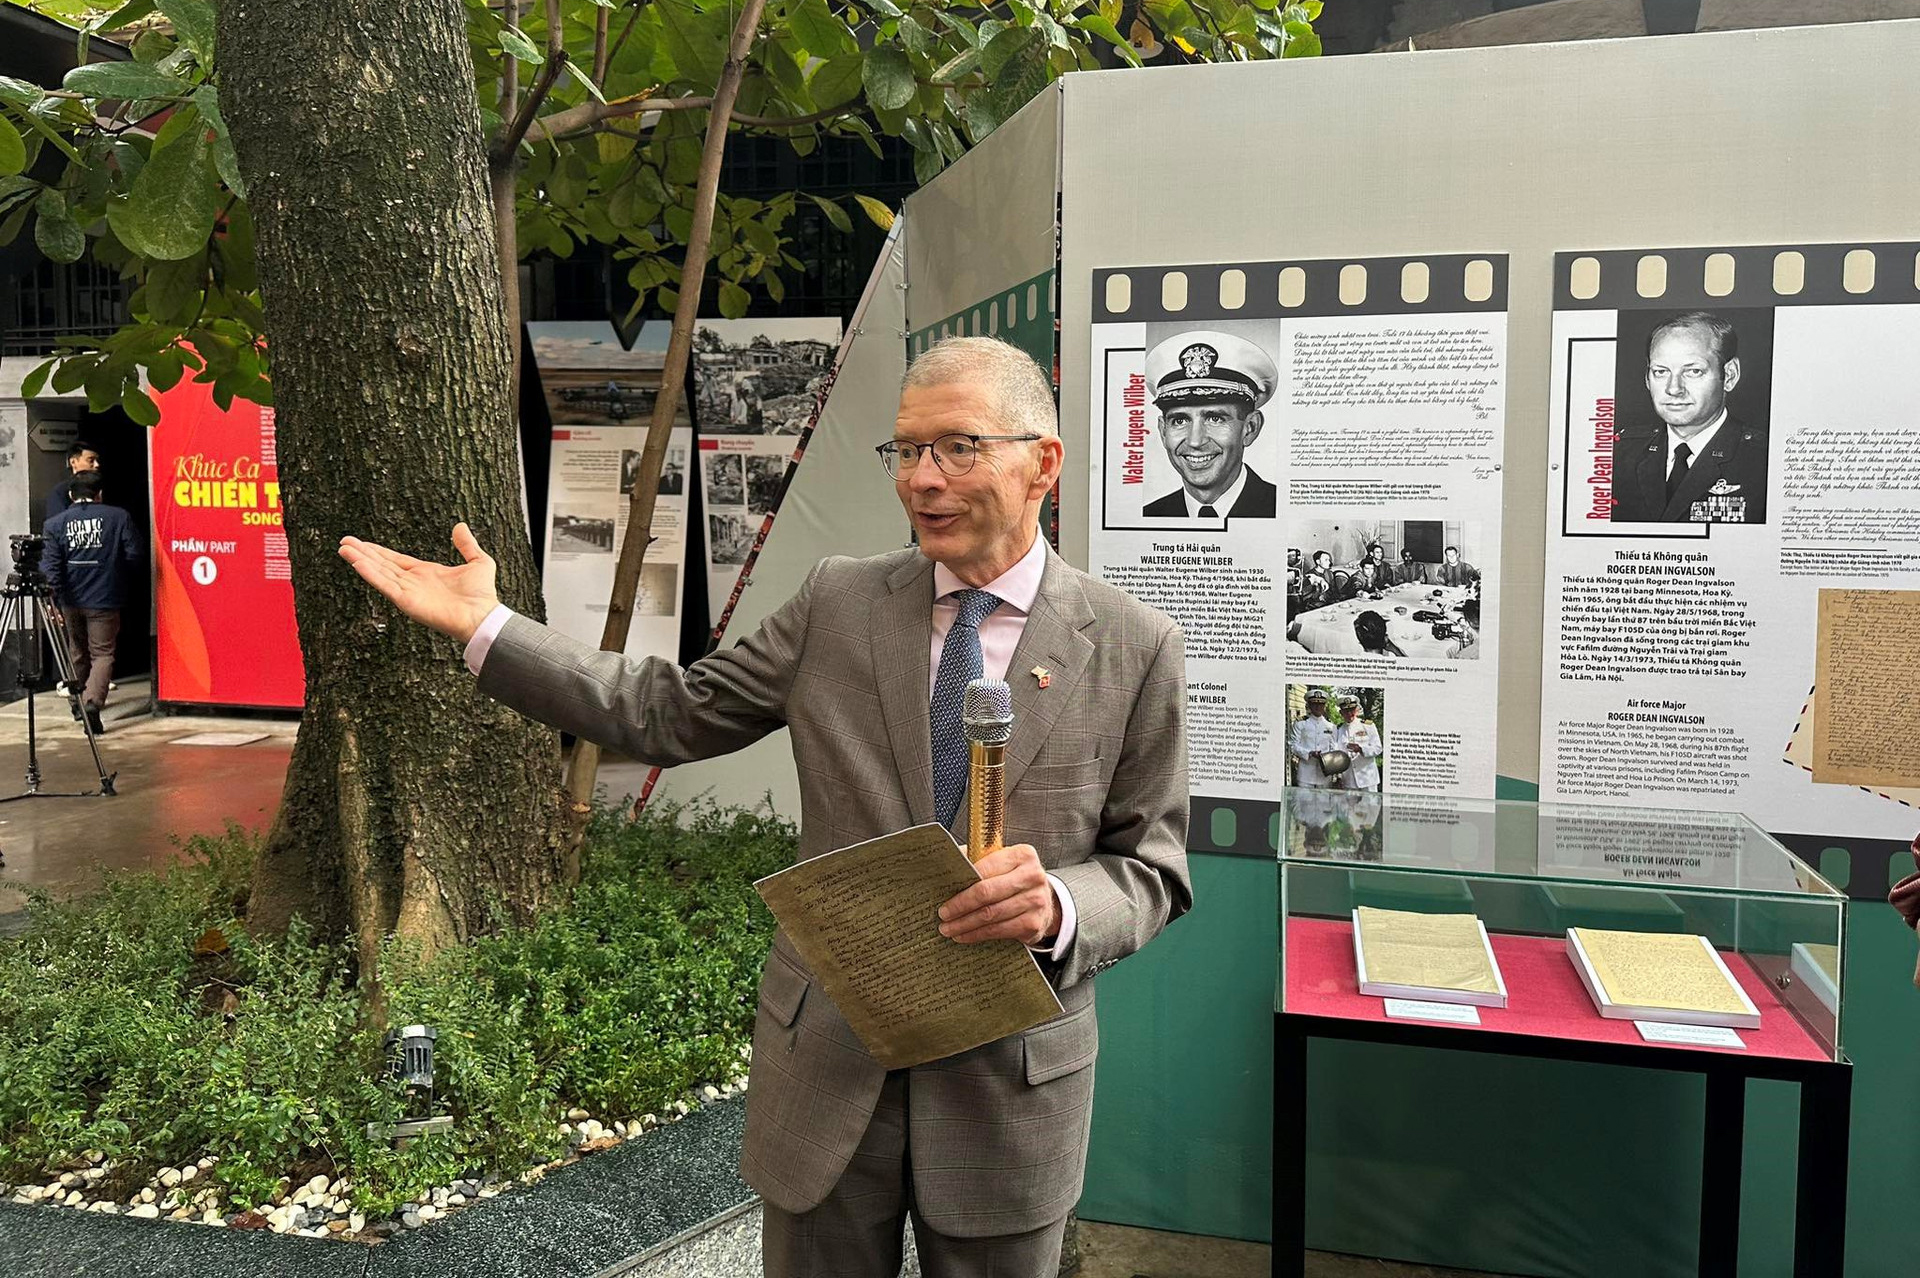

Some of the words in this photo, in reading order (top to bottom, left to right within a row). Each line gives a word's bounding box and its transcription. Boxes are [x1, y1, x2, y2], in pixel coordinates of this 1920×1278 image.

[1123, 374, 1145, 407] Wilber
[1123, 410, 1150, 447] Eugene
[1588, 399, 1620, 452] Ingvalson
[175, 453, 227, 482] Khúc
[233, 456, 260, 478] Ca
[1122, 450, 1144, 484] Walter
[1587, 456, 1612, 483] Dean
[1586, 486, 1618, 519] Roger
[242, 512, 282, 525] SONG
[1153, 544, 1174, 554] Trung
[1200, 544, 1220, 555] quân
[1140, 555, 1170, 563] WALTER
[1171, 555, 1201, 564] EUGENE
[1202, 556, 1232, 564] WILBER
[1615, 552, 1639, 560] Thiếu
[1641, 552, 1651, 560] tá
[1653, 552, 1682, 563] Không
[1684, 553, 1708, 564] quân
[1606, 565, 1636, 573] ROGER
[1638, 565, 1662, 574] DEAN
[1664, 566, 1715, 575] INGVALSON
[1200, 683, 1227, 691] Colonel
[1199, 694, 1226, 703] WILBER
[1640, 700, 1660, 709] force
[1662, 701, 1686, 711] Major
[1607, 712, 1634, 721] ROGER
[1635, 713, 1657, 722] DEAN
[1659, 714, 1704, 723] INGVALSON
[1586, 722, 1604, 730] Major
[1605, 722, 1625, 731] Roger
[1644, 724, 1676, 733] Ingvalson
[1655, 733, 1676, 742] began
[1677, 734, 1704, 743] carrying
[1634, 741, 1648, 749] May
[1679, 743, 1702, 751] during
[1730, 745, 1749, 753] flight
[1578, 755, 1598, 763] Roger
[1617, 757, 1649, 766] Ingvalson
